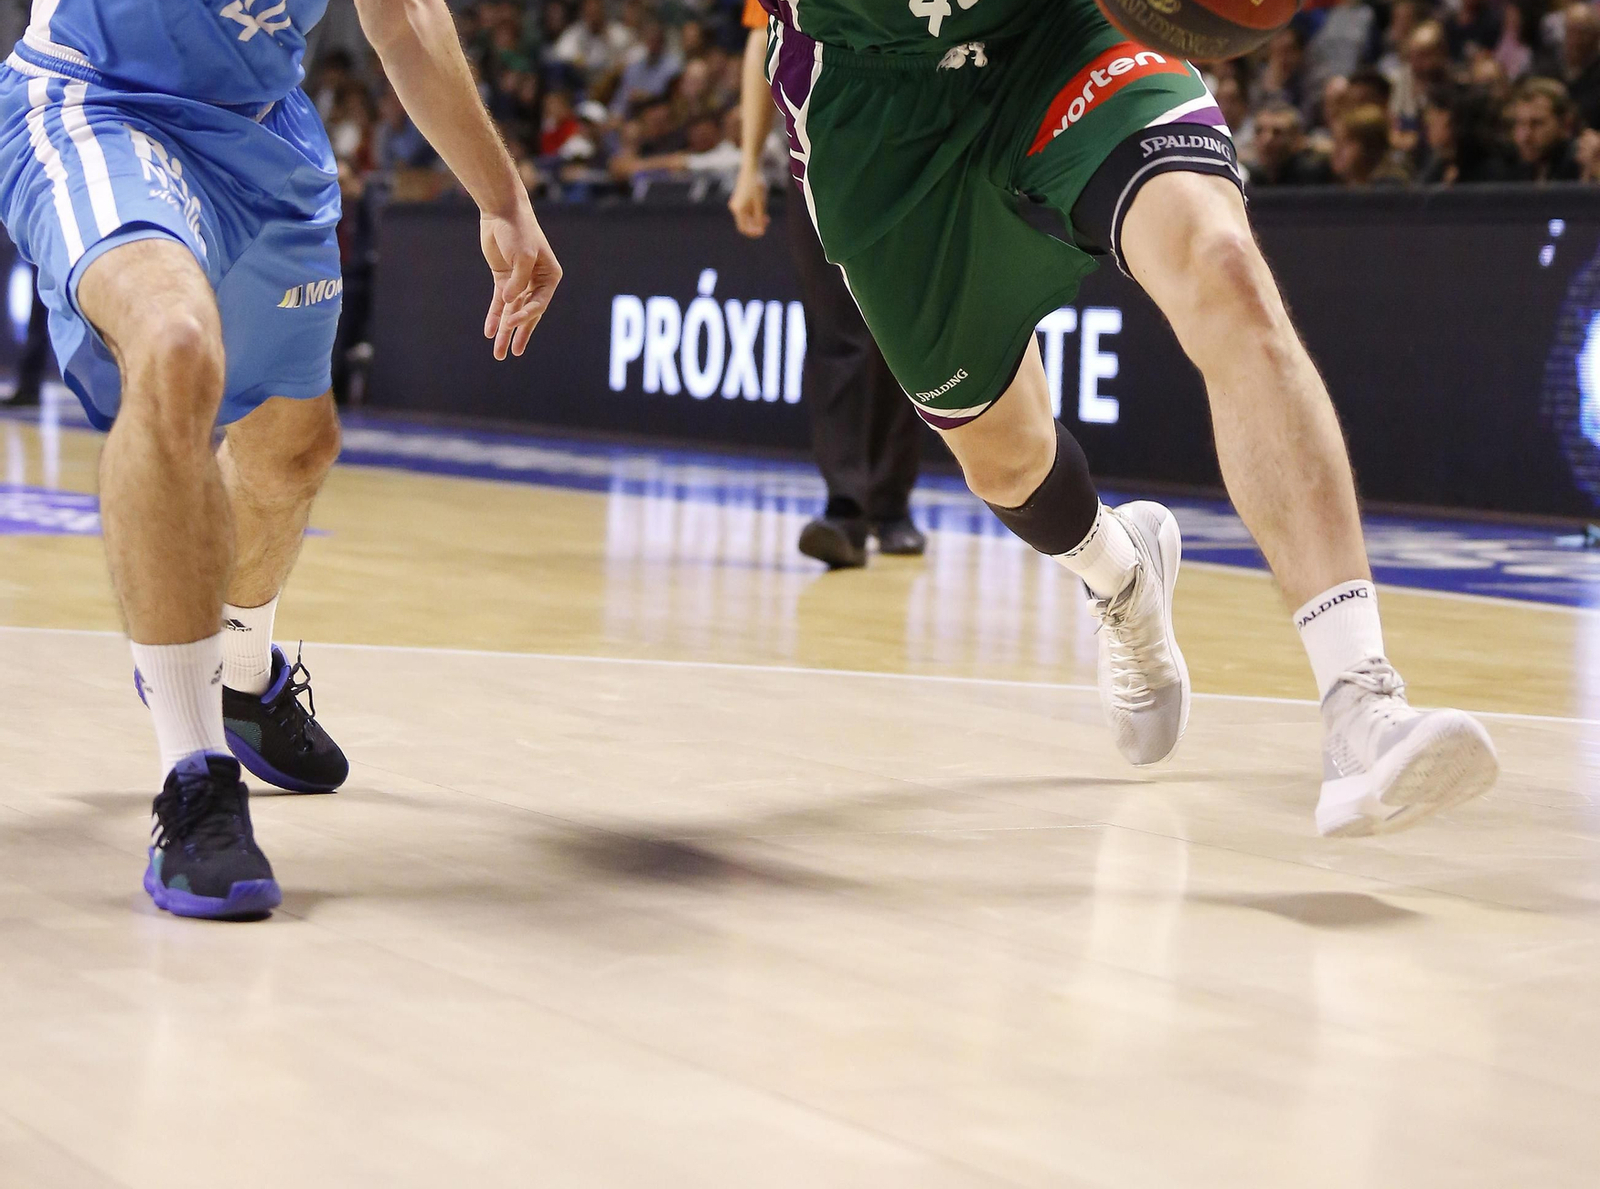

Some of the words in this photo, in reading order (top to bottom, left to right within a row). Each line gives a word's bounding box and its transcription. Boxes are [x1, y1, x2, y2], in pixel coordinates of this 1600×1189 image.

[1139, 134, 1232, 161] SPALDING
[304, 276, 343, 307] MON
[915, 368, 968, 403] SPALDING
[1298, 587, 1368, 631] ALDING
